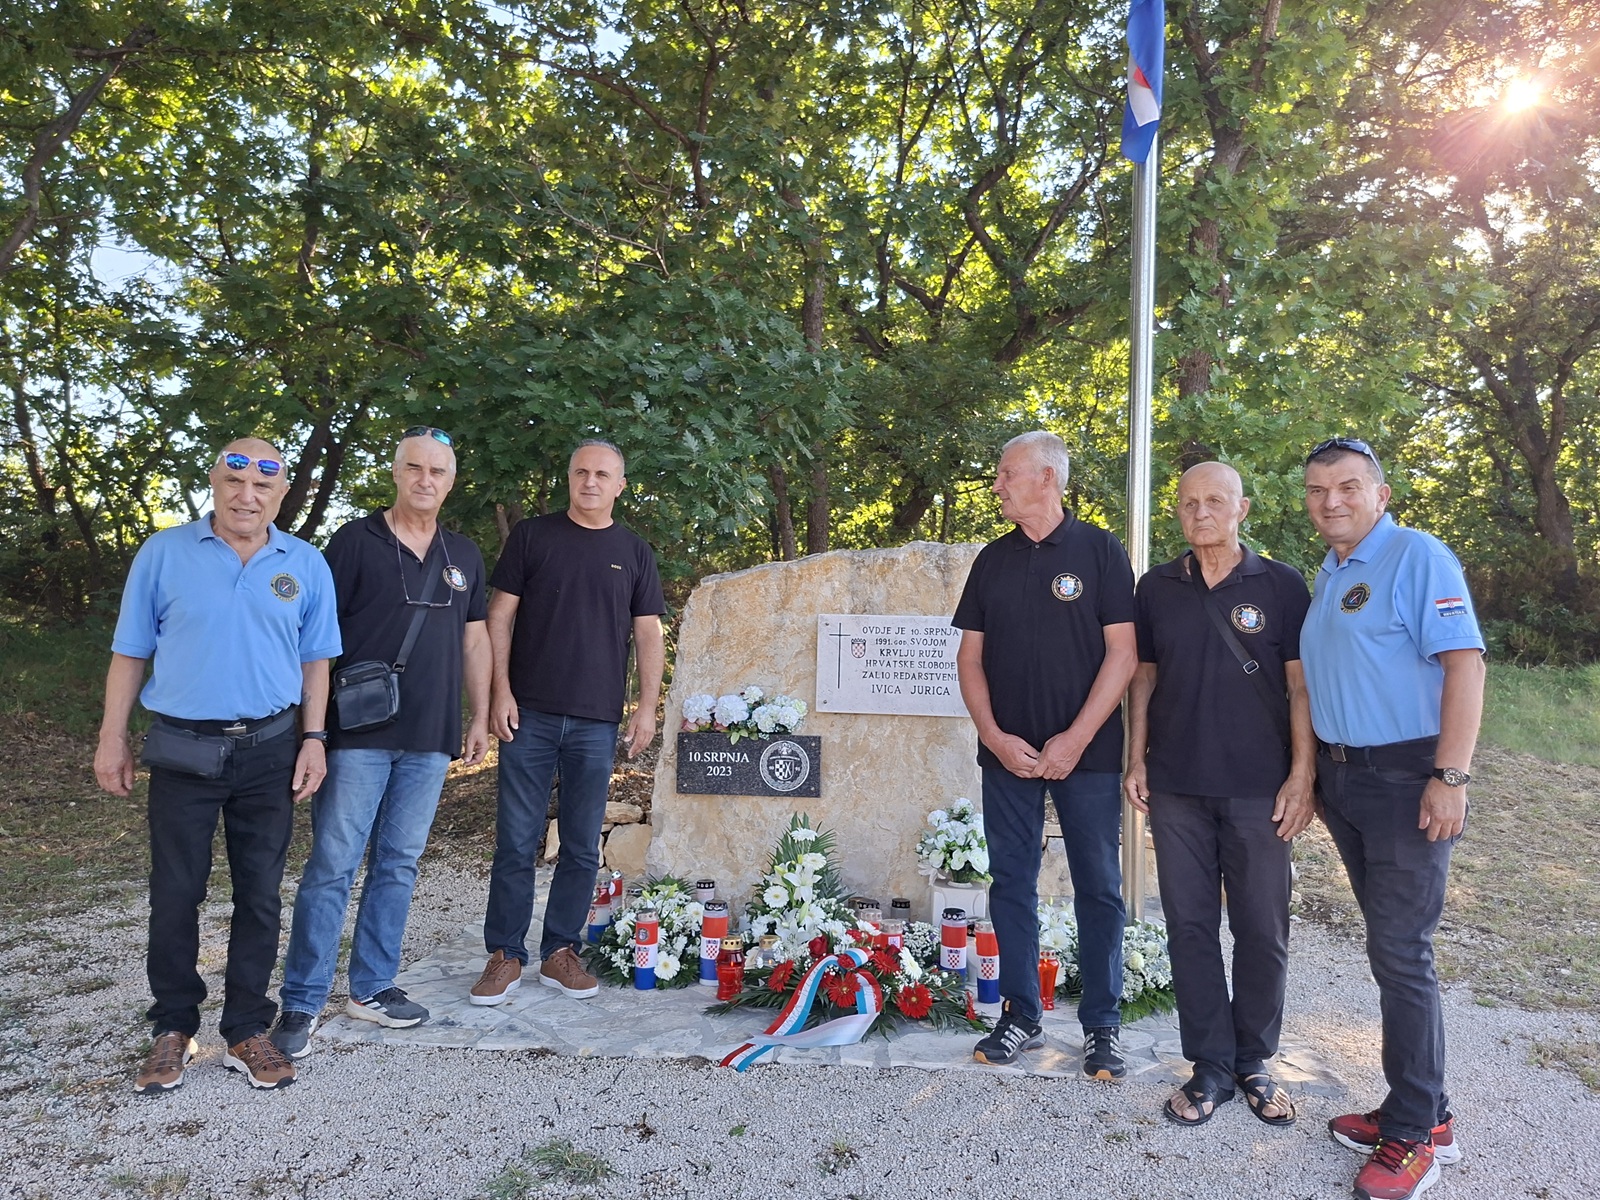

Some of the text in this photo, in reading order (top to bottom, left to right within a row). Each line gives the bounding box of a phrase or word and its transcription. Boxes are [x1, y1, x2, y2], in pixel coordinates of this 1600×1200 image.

[862, 626, 892, 635] OVDJE
[894, 626, 906, 635] JE
[923, 627, 960, 637] SRPNJA
[909, 637, 947, 647] SVOJOM
[879, 647, 944, 658] KRVLJU RUŽU
[865, 659, 956, 670] HRVATSKE SLOBODE
[862, 670, 959, 682] ZALIO REDARSTVENI
[871, 684, 951, 696] IVICA JURICA
[689, 751, 750, 763] 10.SRPNJA
[706, 765, 732, 777] 2023
